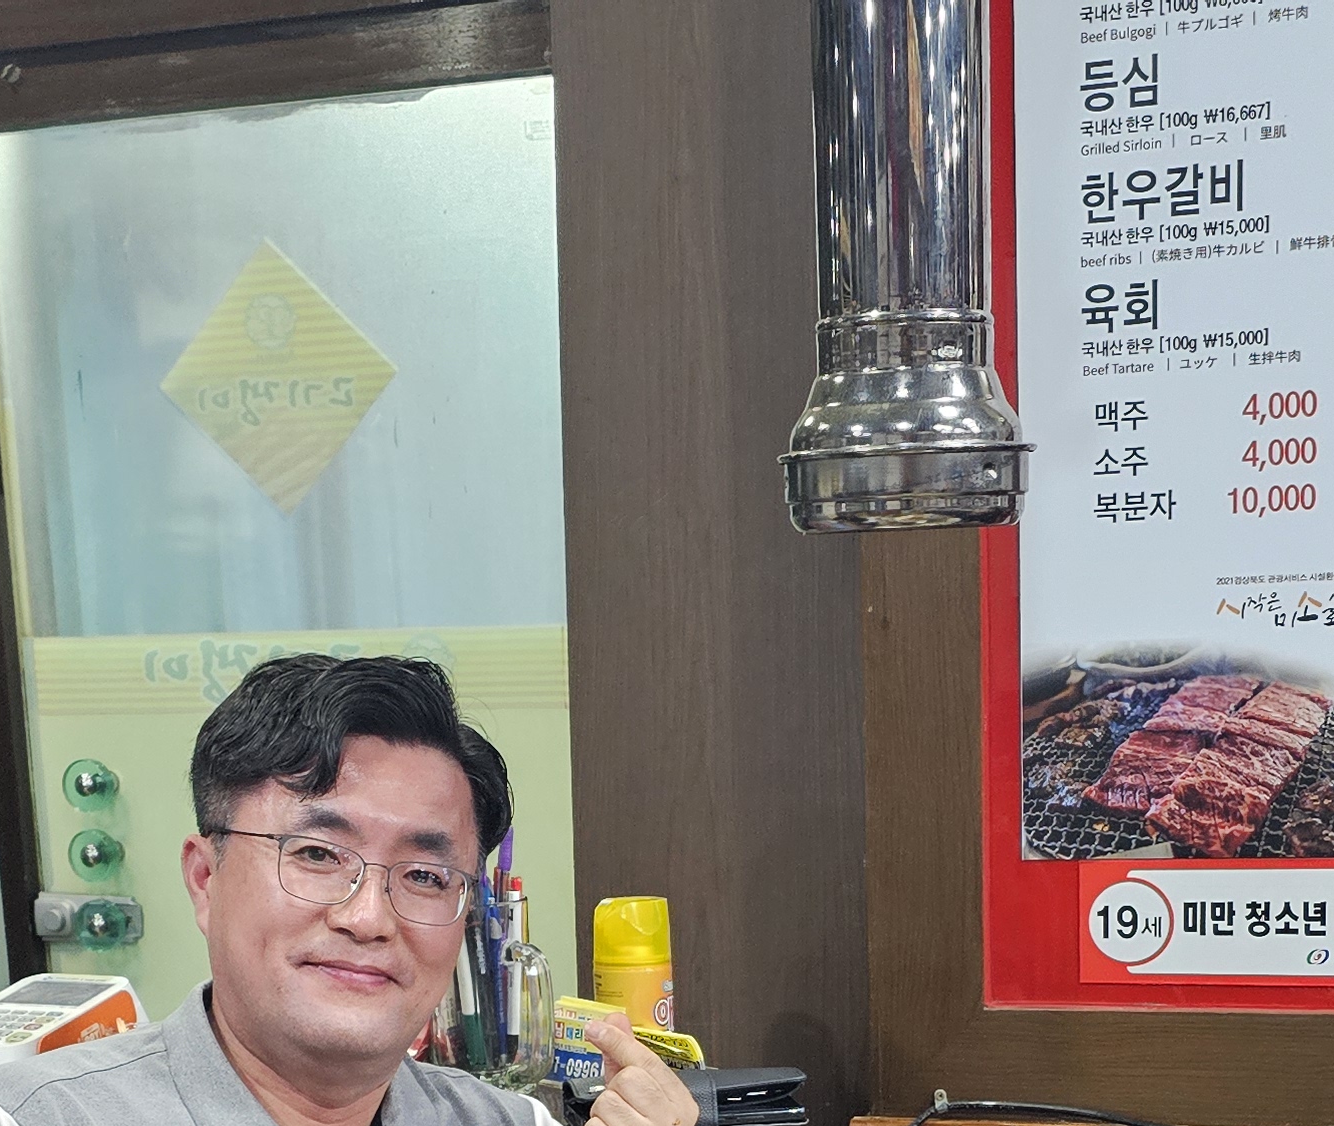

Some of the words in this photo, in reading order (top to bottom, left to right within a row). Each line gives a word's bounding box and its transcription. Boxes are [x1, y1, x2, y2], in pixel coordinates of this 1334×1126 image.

[1079, 5, 1122, 24] 국내산
[1125, 0, 1155, 19] 한우
[1080, 31, 1107, 44] Beef
[1110, 24, 1157, 41] Bulgogi
[1079, 53, 1159, 113] 등심
[1080, 117, 1123, 138] 국내산
[1125, 114, 1155, 133] 한우
[1159, 111, 1198, 131] [100g
[1080, 141, 1120, 157] Grilled
[1123, 137, 1162, 153] Sirloin
[1190, 130, 1228, 146] ロース
[1080, 158, 1244, 225] 한우갈비
[1080, 228, 1123, 248] 국내산
[1125, 225, 1155, 244] 한우
[1159, 223, 1198, 243] [100g
[1080, 255, 1107, 268] beef
[1109, 253, 1132, 266] ribs
[1081, 278, 1159, 334] 육회
[1081, 339, 1124, 359] 국내산
[1125, 337, 1155, 356] 한우
[1159, 335, 1198, 353] [100g
[1082, 363, 1109, 377] Beef
[1113, 361, 1155, 374] Tartare
[1179, 355, 1218, 370] ユッケ
[1094, 399, 1149, 432] 맥주
[1241, 389, 1318, 426] 4,000
[1093, 446, 1149, 476] 소주
[1241, 436, 1318, 472] 4,000
[1093, 488, 1177, 523] 복분자
[1227, 483, 1317, 518] 10,000
[1095, 904, 1163, 941] 19세
[1181, 900, 1237, 938] 미만
[1244, 900, 1327, 938] 청소년
